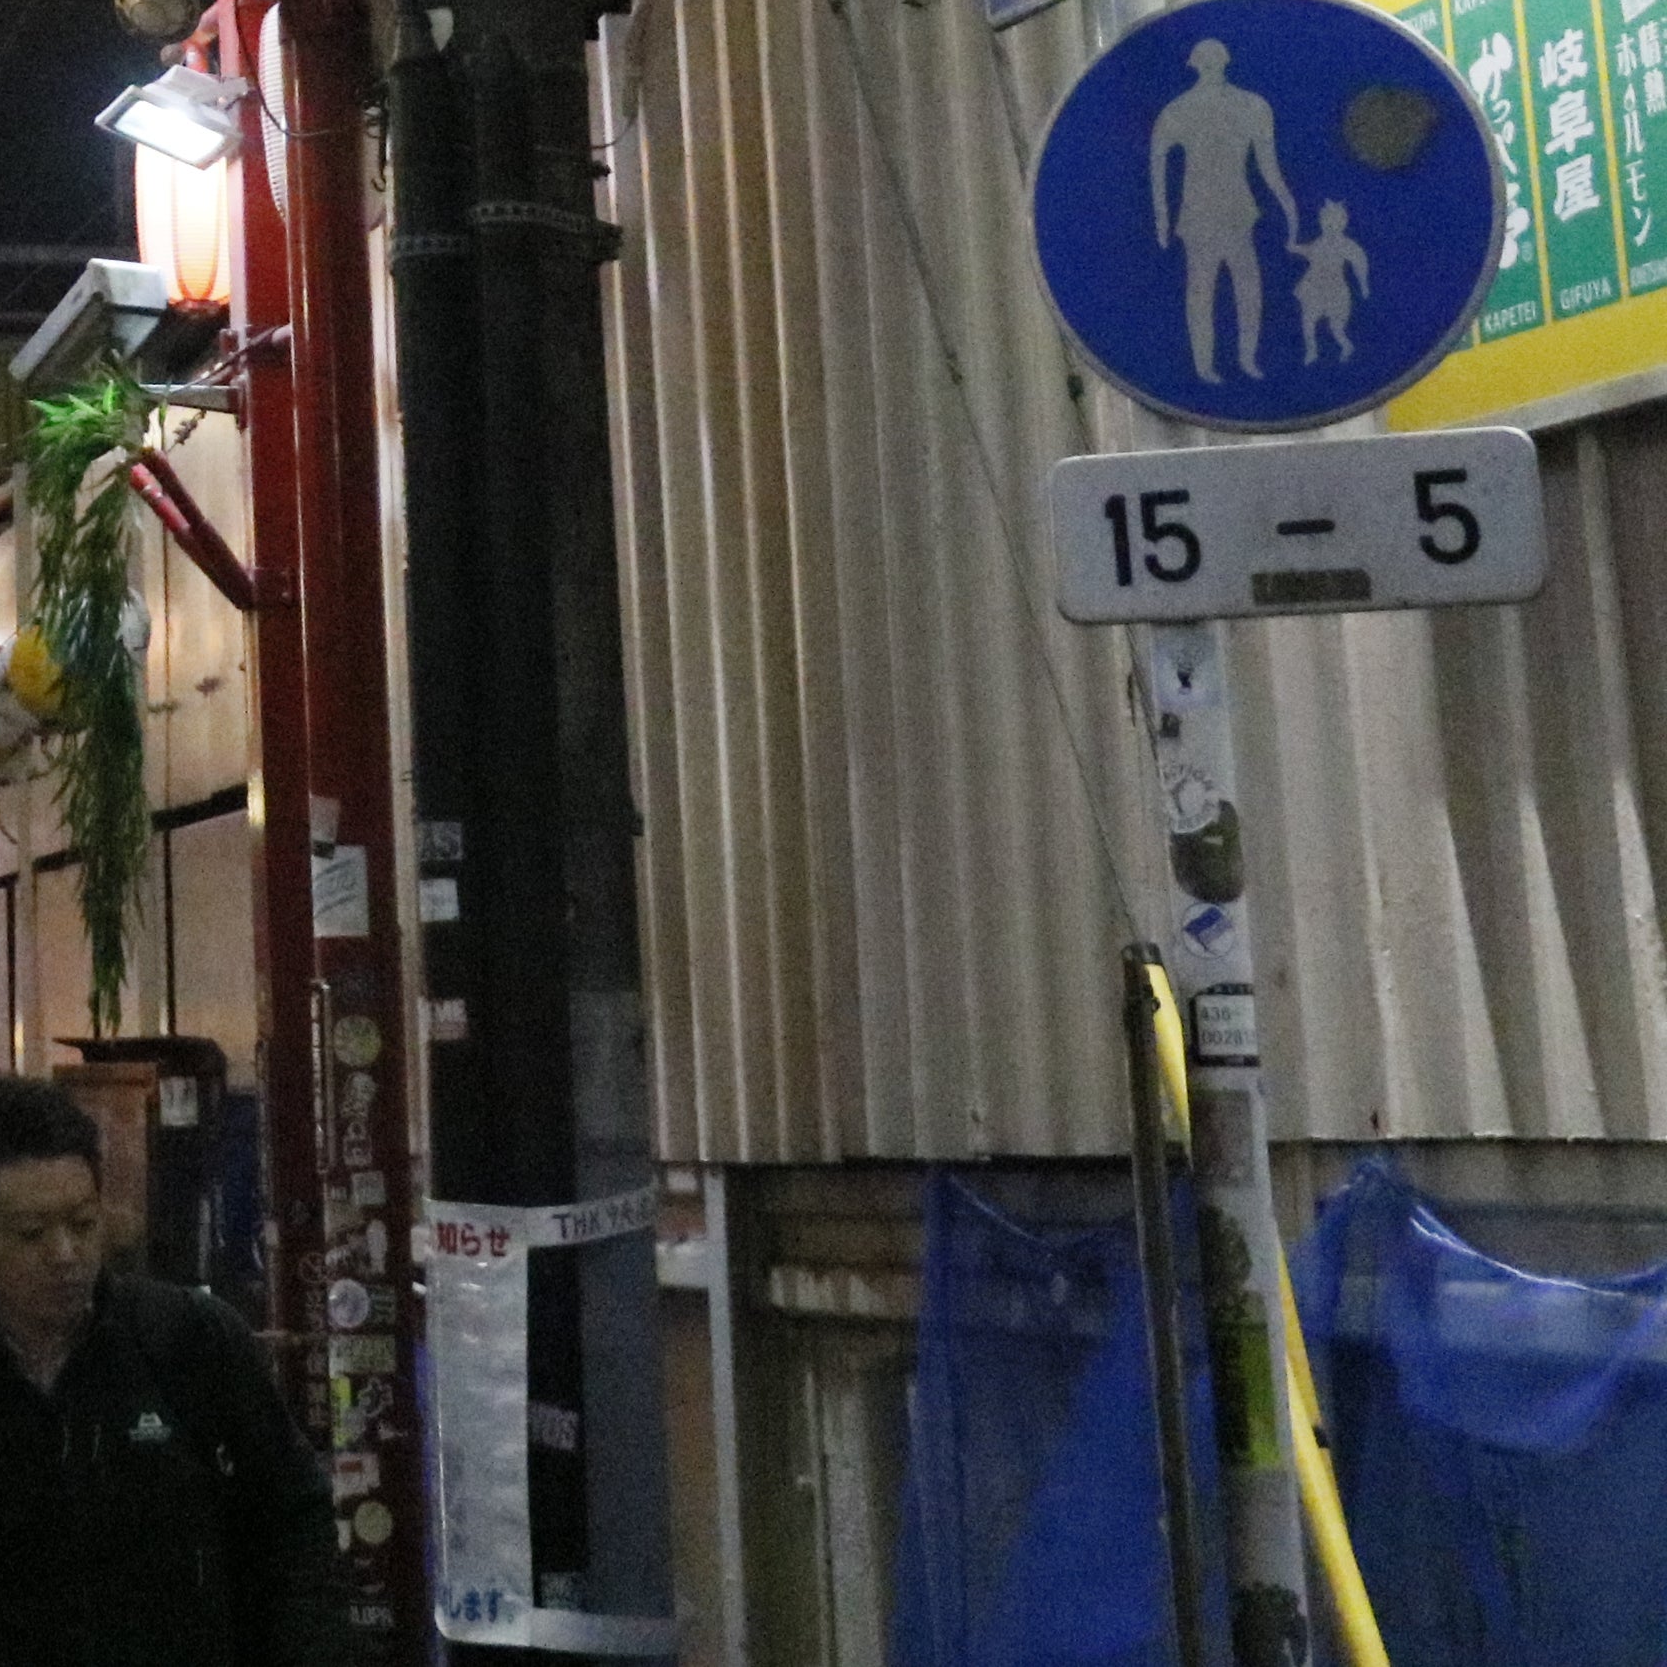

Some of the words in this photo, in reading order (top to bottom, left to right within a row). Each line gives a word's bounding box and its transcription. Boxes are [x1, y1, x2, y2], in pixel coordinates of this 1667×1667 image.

[1539, 27, 1601, 223] 岐阜屋
[1483, 300, 1537, 332] KAPETEI
[1559, 276, 1612, 310] GIFUYA
[1103, 489, 1203, 586] 15
[1413, 468, 1482, 566] 5
